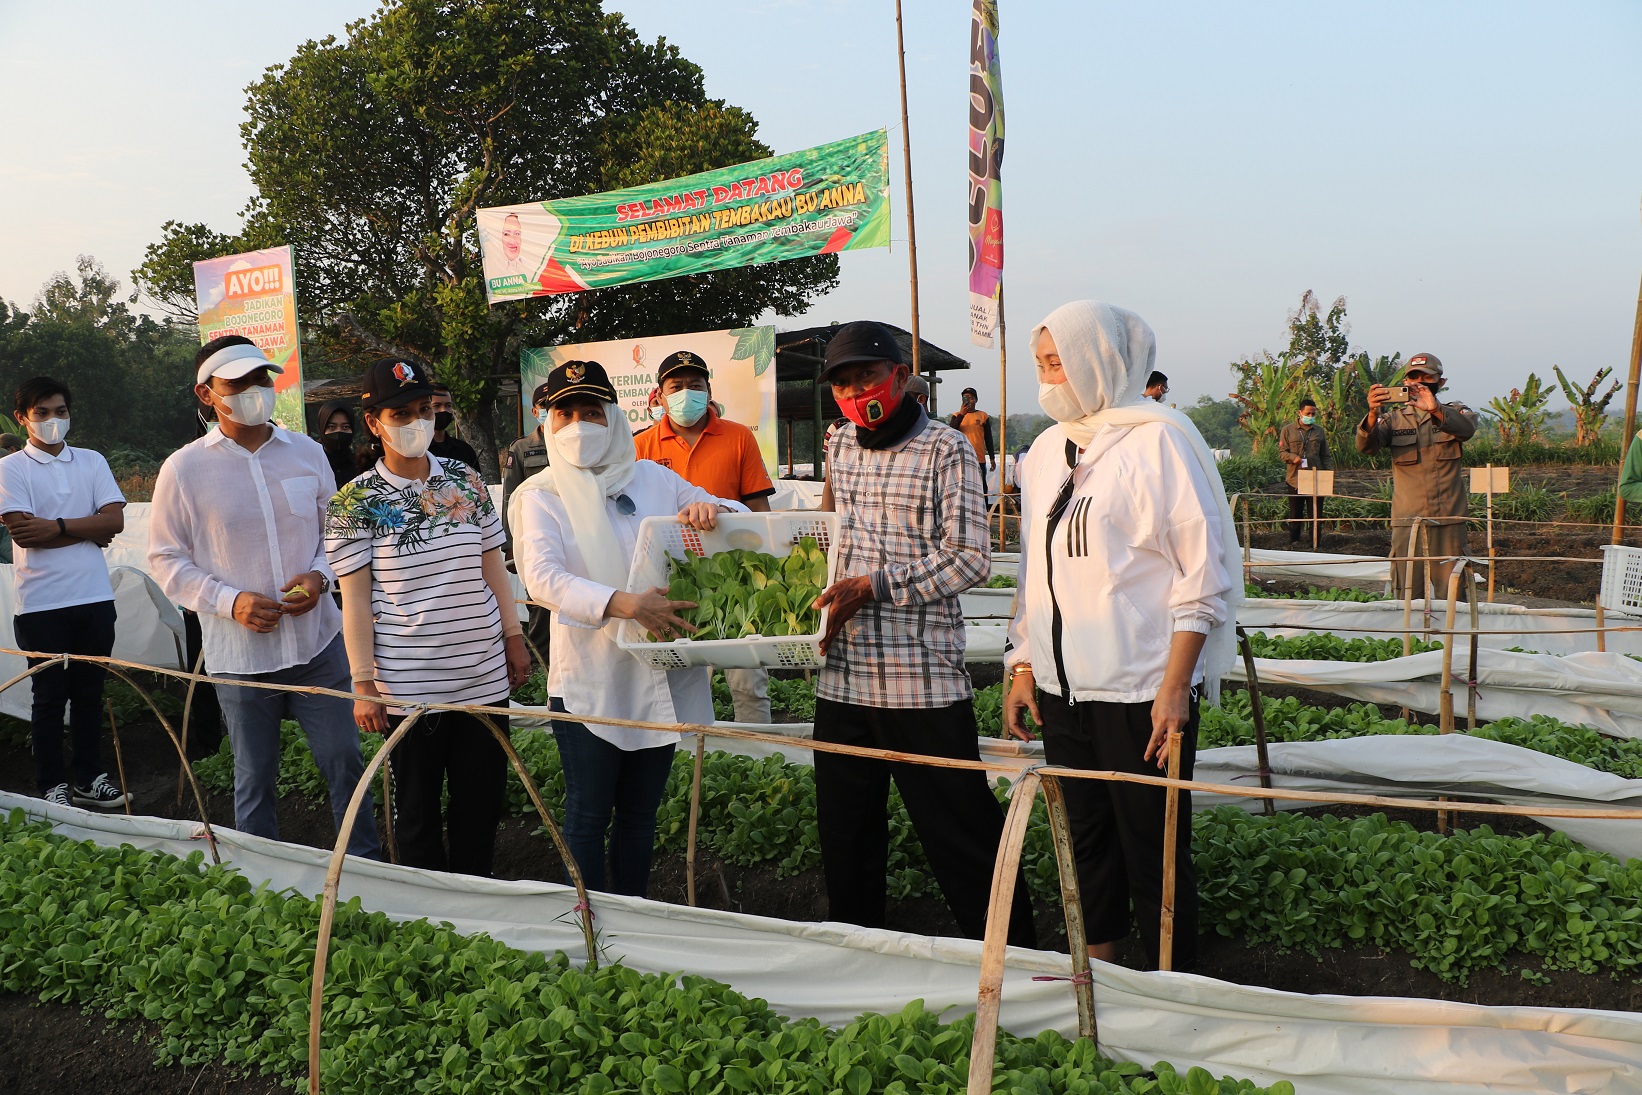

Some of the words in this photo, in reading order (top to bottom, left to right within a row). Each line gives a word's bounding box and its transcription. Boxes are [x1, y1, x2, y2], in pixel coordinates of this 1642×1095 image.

[616, 188, 708, 222] SELAMAT
[711, 168, 804, 205] DATANG
[569, 234, 584, 253] DI
[586, 227, 628, 251] KEBUN
[630, 213, 711, 245] PEMBIBITAN
[712, 195, 793, 230] TEMBAKAU
[795, 192, 818, 214] BU
[820, 182, 866, 210] ANNA
[598, 252, 630, 266] Jadikan
[633, 245, 686, 263] Bojonegoro
[687, 239, 720, 252] Sentra
[720, 231, 769, 247] Tanaman
[771, 219, 825, 238] Tembakau
[228, 267, 280, 296] AYO!!!
[491, 279, 502, 288] BU
[503, 275, 525, 287] ANNA
[244, 297, 283, 312] JADIKAN
[224, 309, 284, 327] BOJONEGORO
[208, 328, 240, 342] SENTRA
[242, 322, 285, 337] TANAMAN
[259, 335, 286, 349] JAWA
[610, 373, 652, 386] TERIMA
